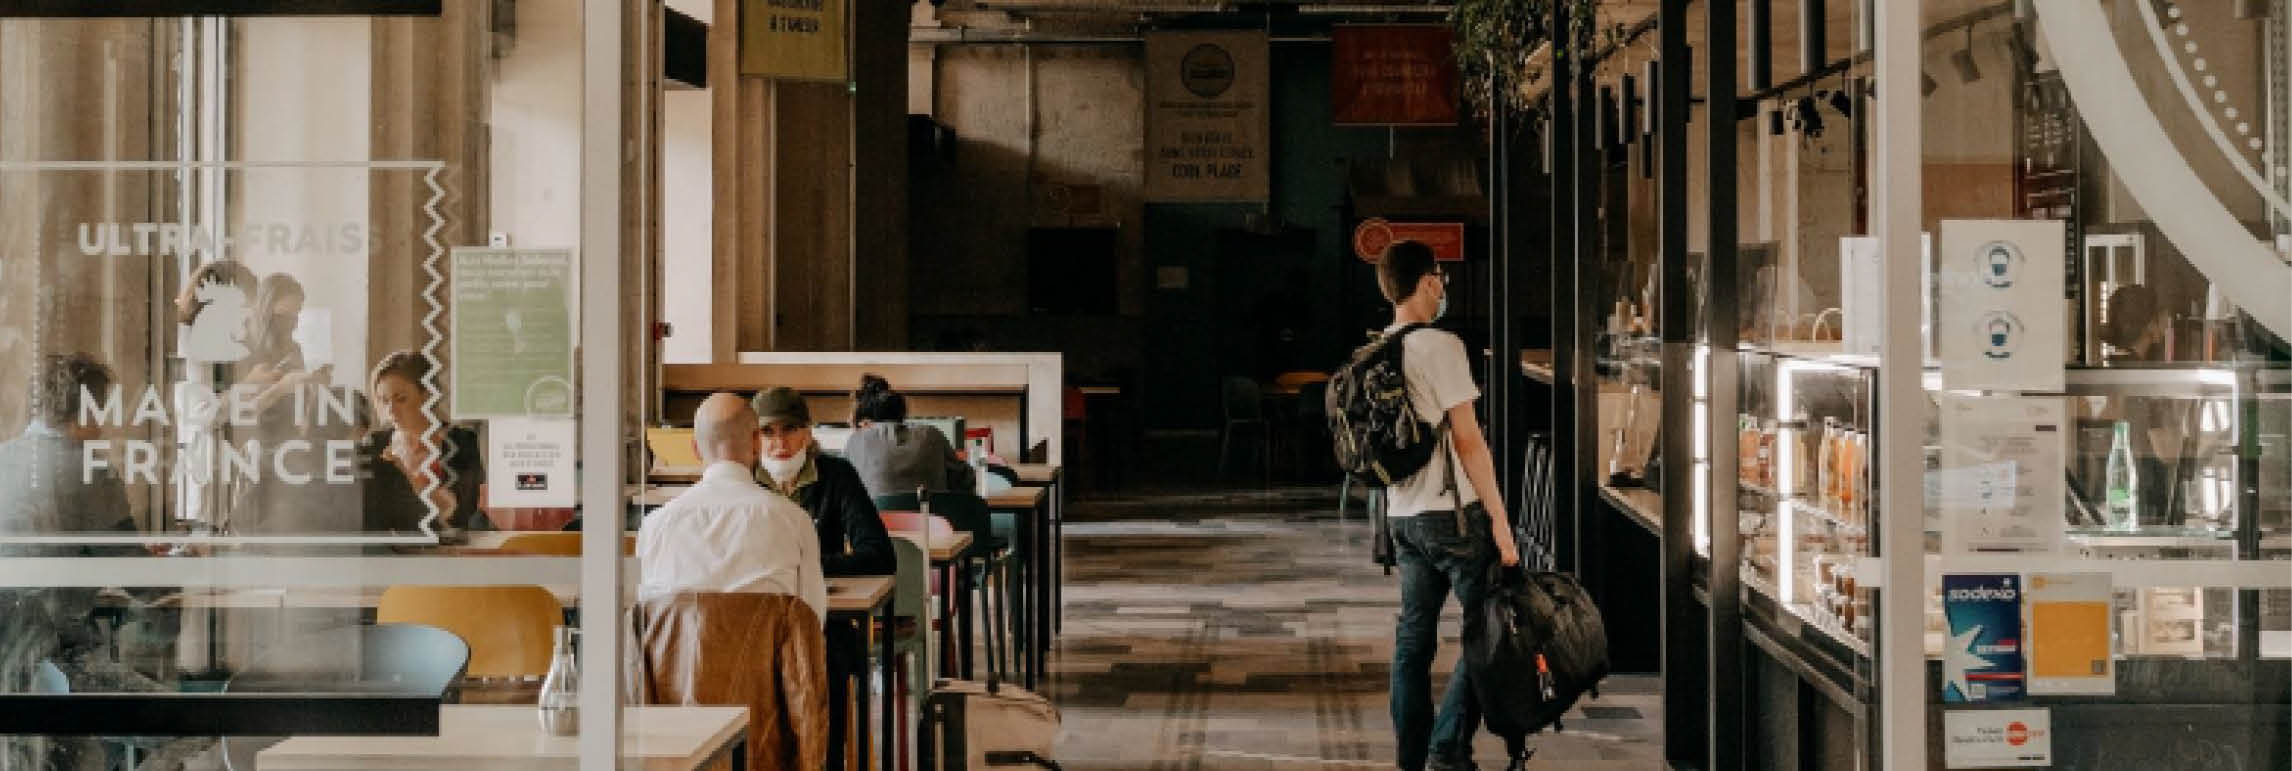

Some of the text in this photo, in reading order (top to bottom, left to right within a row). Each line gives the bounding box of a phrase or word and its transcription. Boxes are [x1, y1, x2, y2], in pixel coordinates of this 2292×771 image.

[79, 383, 355, 426] MADE IN
[82, 439, 355, 484] FRANCE
